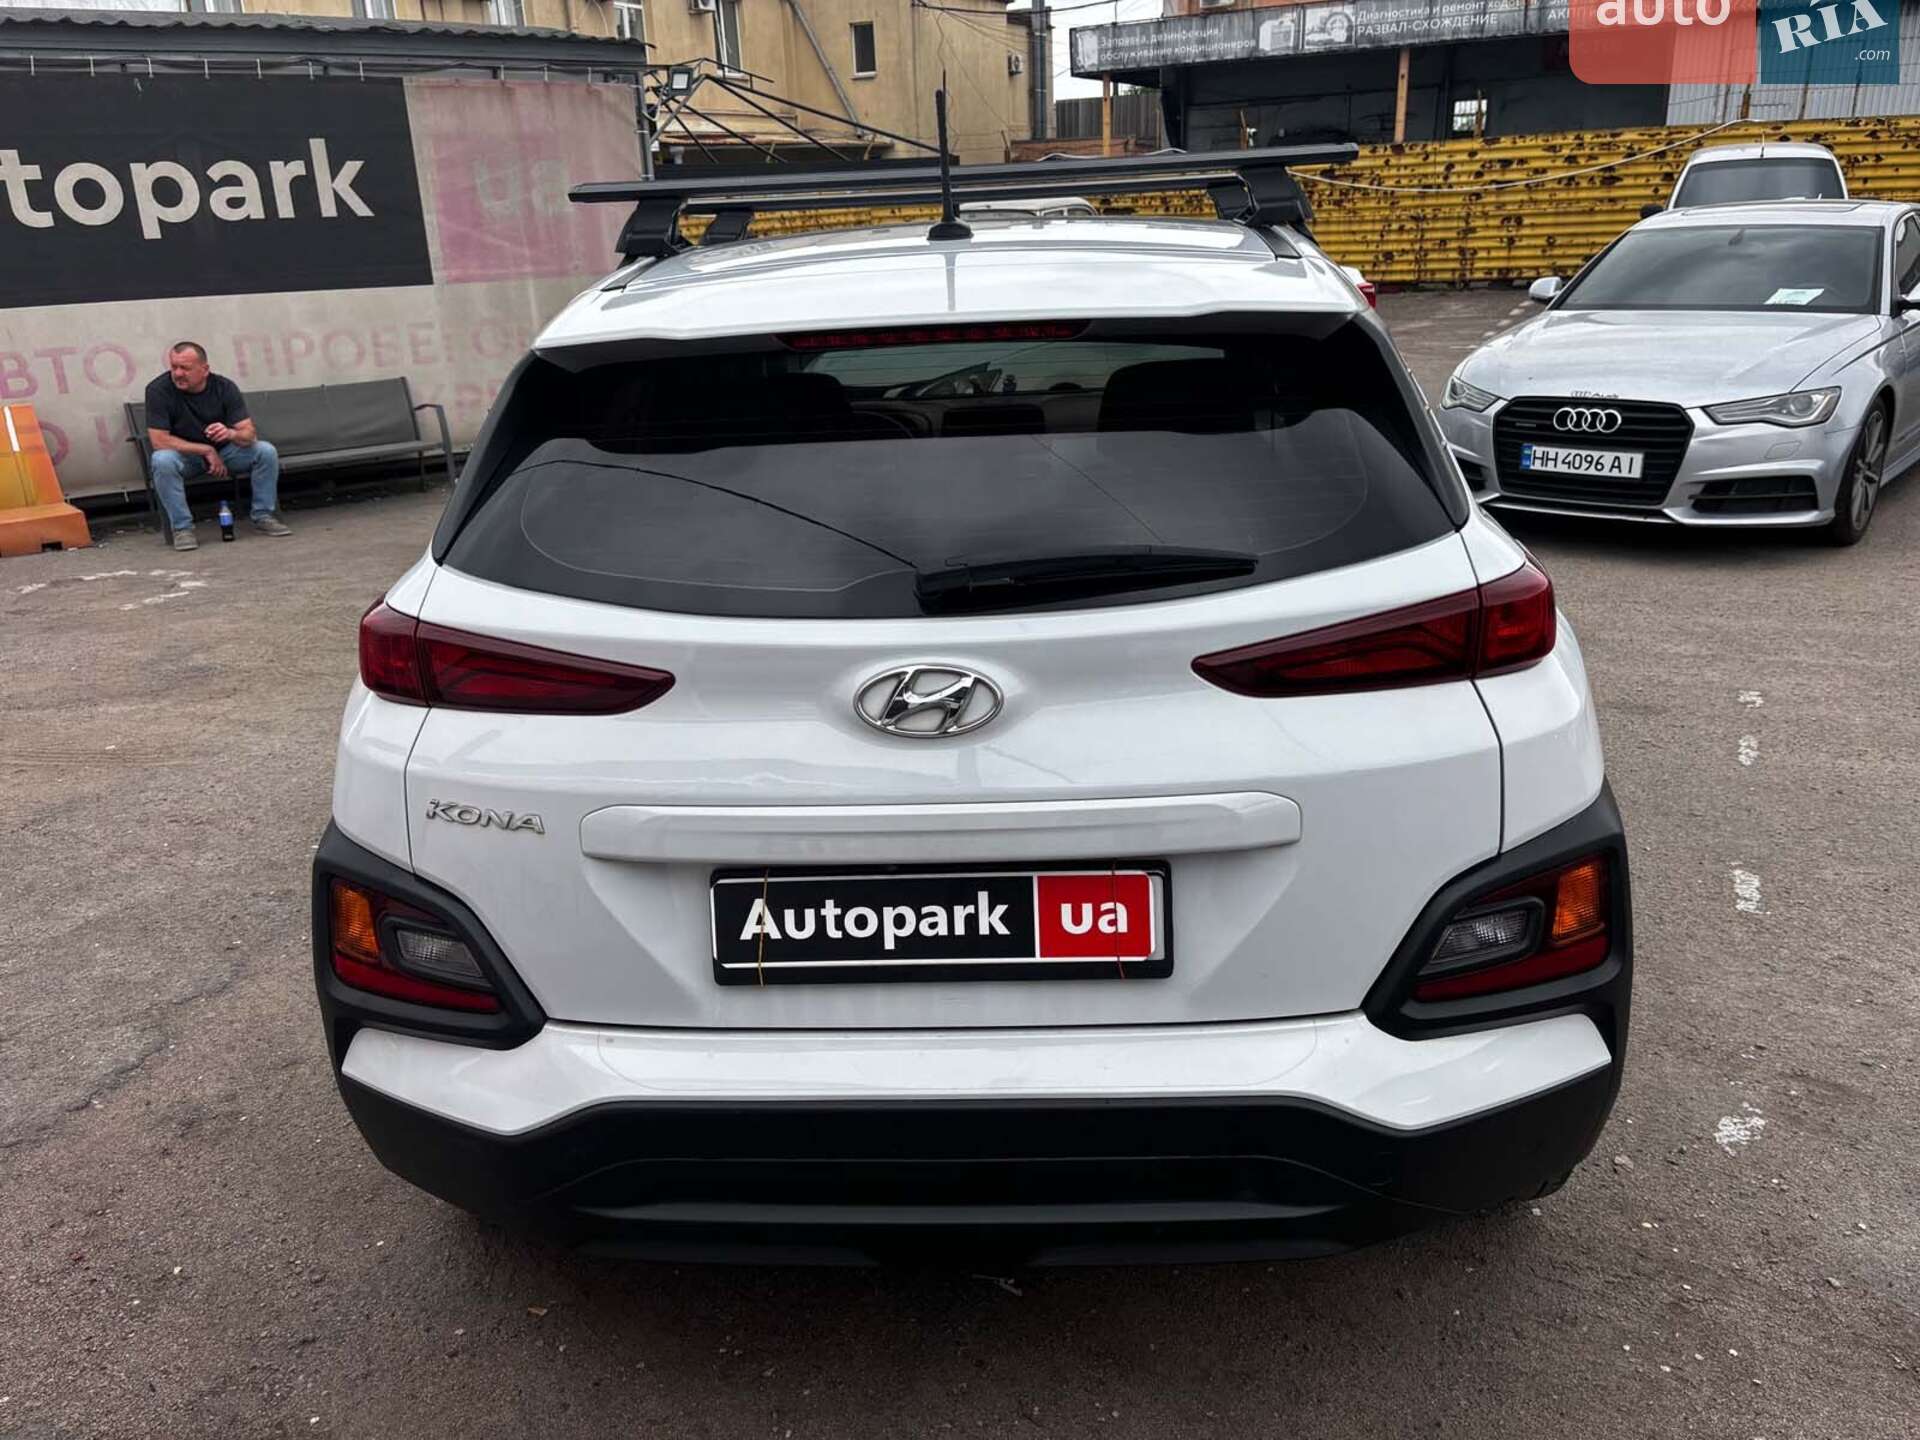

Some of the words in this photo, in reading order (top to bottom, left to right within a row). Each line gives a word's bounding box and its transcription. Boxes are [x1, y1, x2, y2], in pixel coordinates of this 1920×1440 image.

[1357, 14, 1498, 37] РАЗВАЛ-СХОЖДЕНИЕ
[1562, 452, 1605, 472] 4096
[426, 798, 546, 835] KONA
[740, 891, 1011, 950] Autopark
[1060, 901, 1128, 935] ua
